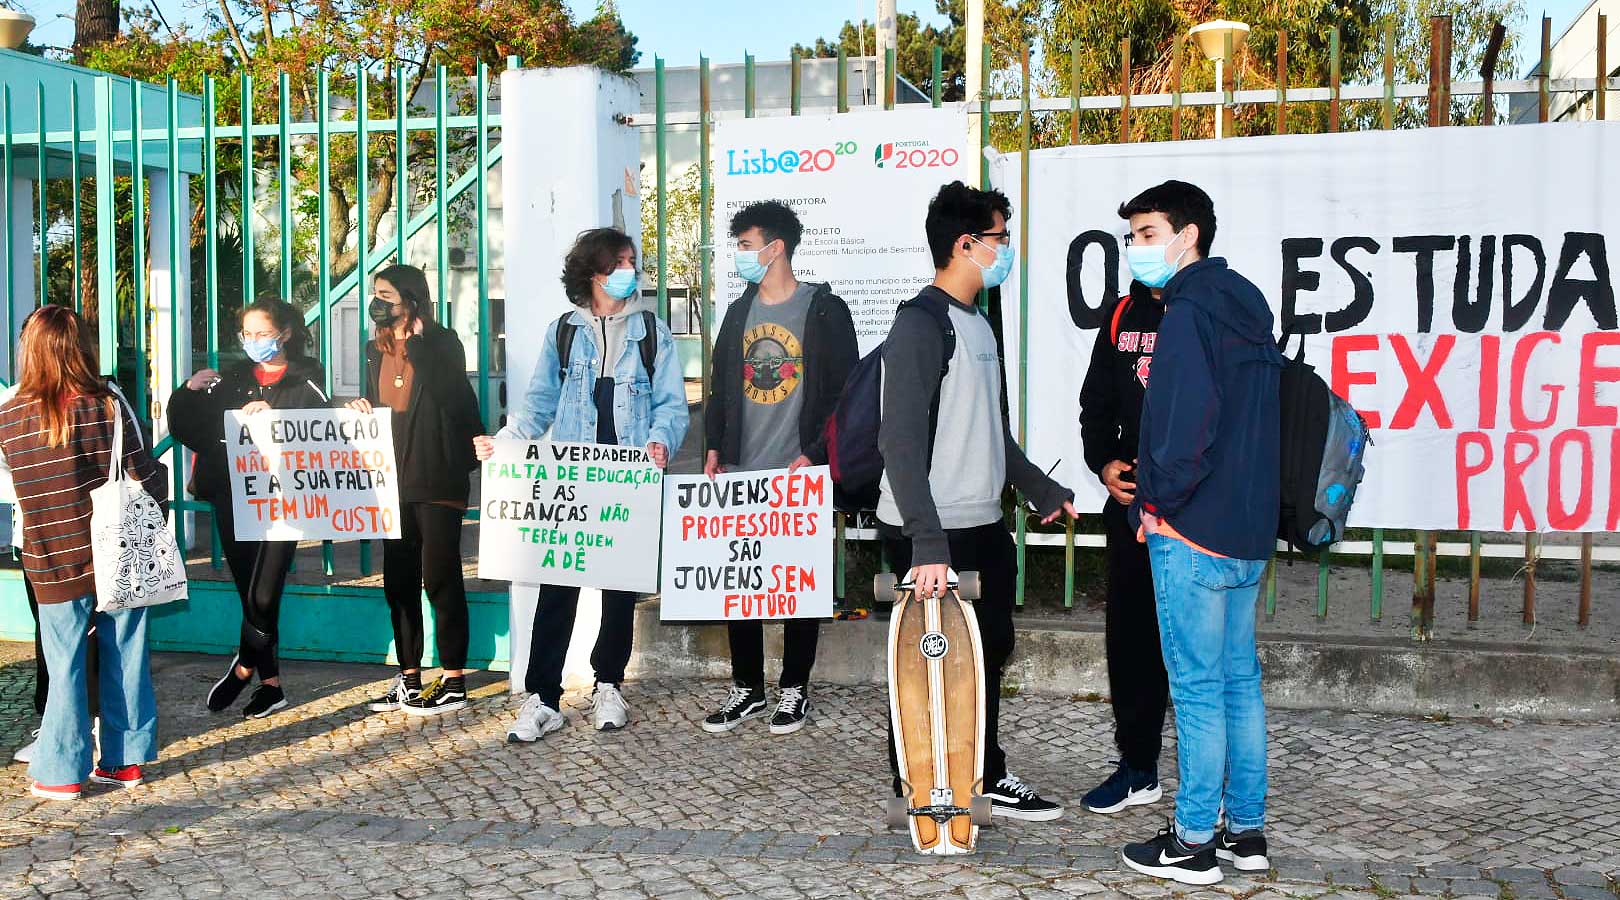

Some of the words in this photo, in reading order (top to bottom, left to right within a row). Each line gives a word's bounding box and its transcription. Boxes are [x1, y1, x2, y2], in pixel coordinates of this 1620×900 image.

[895, 148, 959, 169] 2020
[800, 227, 841, 236] PROJETO
[814, 238, 839, 246] Escola
[1066, 230, 1119, 330] O
[239, 423, 254, 446] A
[236, 450, 270, 473] NÃO
[281, 450, 324, 471] TEM
[526, 444, 539, 461] A
[551, 444, 650, 463] VERDADEIRA
[244, 475, 257, 496] E
[268, 474, 281, 494] A
[293, 469, 331, 490] SUA
[334, 469, 386, 491] FALTA
[487, 463, 548, 481] FALTA
[557, 465, 579, 481] DE
[586, 466, 661, 490] EDUCAÇÃO
[532, 480, 541, 500] É
[553, 484, 576, 501] AS
[677, 477, 769, 509] JOVENS
[768, 474, 824, 508] SEM
[248, 496, 298, 522] TEM
[303, 493, 329, 519] UM
[332, 506, 393, 533] CUSTO
[486, 500, 588, 530] CRIANÇAS
[600, 503, 630, 522] NÃO
[682, 511, 819, 541] PROFESSORES
[574, 531, 614, 548] QUEM
[728, 538, 762, 562] SÃO
[541, 549, 556, 568] A
[562, 547, 587, 572] DÊ
[674, 565, 763, 591] JOVENS
[767, 564, 816, 593] SEM
[724, 594, 797, 618] FUTURO
